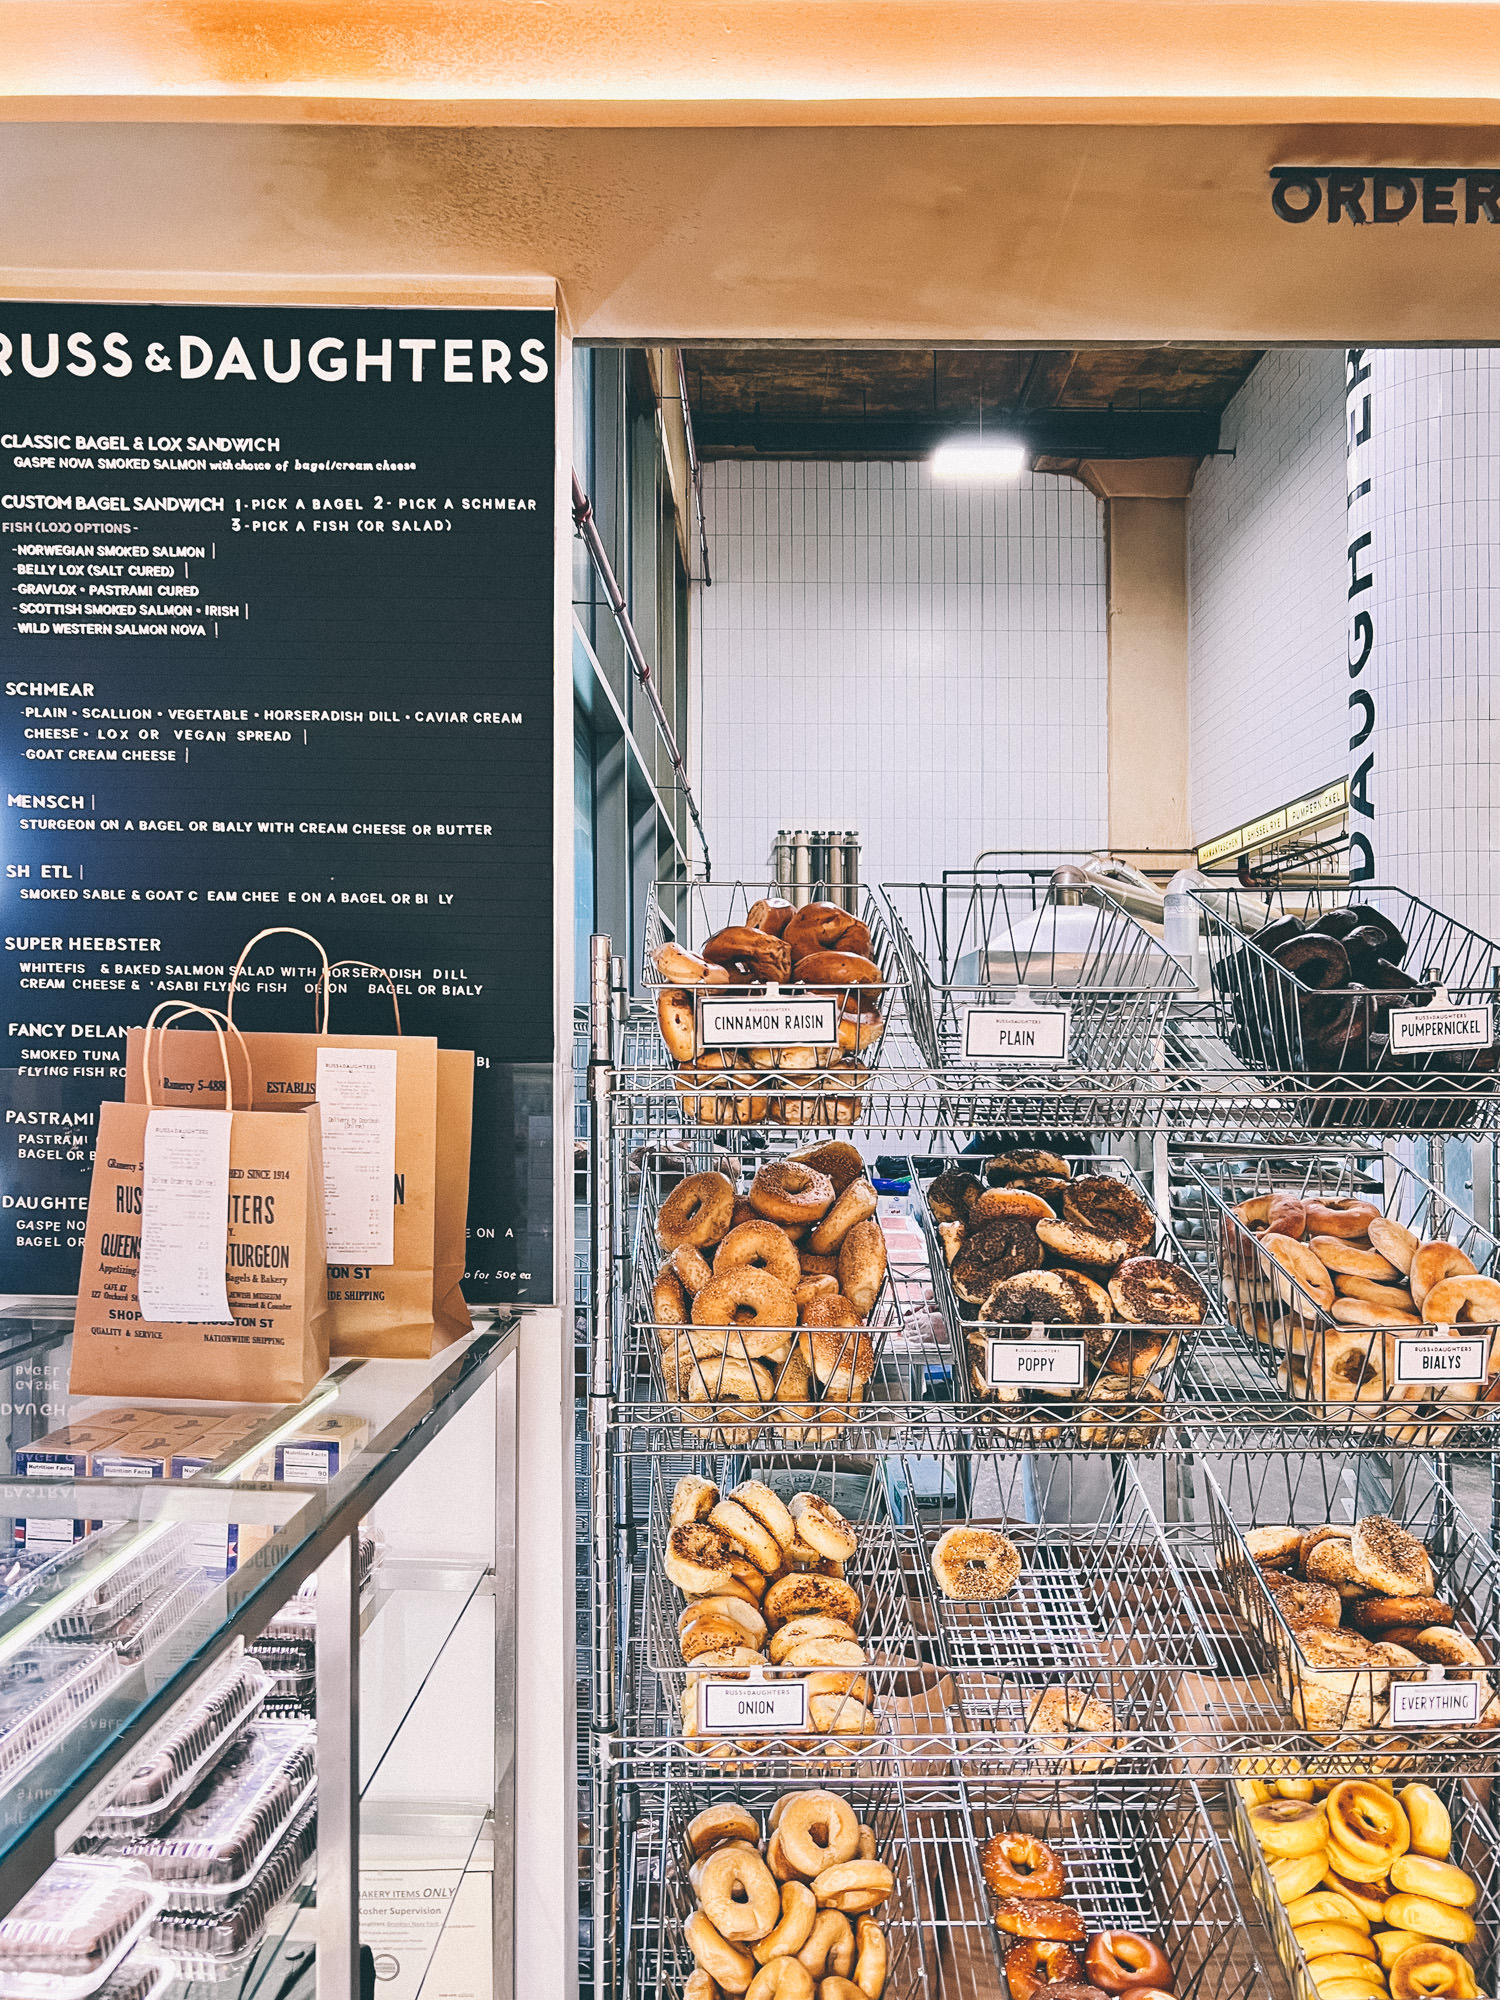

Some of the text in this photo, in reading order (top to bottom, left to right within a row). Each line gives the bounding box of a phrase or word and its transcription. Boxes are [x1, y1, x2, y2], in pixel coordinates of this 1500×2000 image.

[1271, 171, 1500, 225] ORDER
[145, 343, 172, 372] &
[180, 336, 548, 383] DAUGHTERS
[1, 435, 279, 452] CLASSIC BAGEL LOX SANDWICH
[14, 457, 55, 468] GASPE
[59, 458, 94, 468] NOVA
[98, 458, 150, 469] SMOKED
[153, 459, 206, 470] SALMON
[275, 461, 289, 471] of
[376, 460, 416, 470] cheese
[2, 495, 536, 512] CUSTOM BAGEL SANDWICH BAGEL PICK SCHMEAR
[3, 522, 71, 533] FISH (LOX)
[314, 520, 451, 532] FISH (OR SALAD)
[97, 546, 149, 557] SMOKED
[153, 547, 204, 558] SALMON
[59, 565, 84, 575] LOX
[87, 565, 124, 576] (SALT
[128, 565, 174, 577] CURED)
[89, 585, 152, 596] PASTRAMI
[158, 585, 199, 596] CURED
[85, 604, 136, 615] SMOKED
[139, 605, 192, 616] SALMON
[205, 605, 239, 616] IRISH
[53, 623, 112, 634] WESTERN
[115, 624, 167, 634] SALMON
[171, 625, 206, 635] NOVA
[6, 682, 93, 696] SCHMEAR
[83, 708, 151, 719] SCALLION
[168, 709, 248, 720] VEGETABLE
[264, 710, 363, 722] HORSERADISH
[370, 711, 400, 721] DILL
[415, 712, 467, 722] CAVIAR
[474, 713, 521, 723] CREAM
[24, 728, 291, 741] CHEESE LOX OR VEGAN SPREAD
[69, 750, 117, 760] CREAM
[122, 750, 175, 760] CHEESE
[8, 795, 83, 808] MENSCH
[20, 819, 491, 835] STURGEON ON BAGEL OR BIALY WITH CREAM CHEESE OR BUTTER
[21, 889, 410, 904] SMOKED SABLE GOAT ON BAGEL OR
[5, 937, 160, 951] SUPER HEEBSTER
[115, 964, 467, 979] BAKED SALMON SALAD WITH DILL
[20, 979, 64, 988] CREAM
[73, 979, 125, 990] CHEESE
[257, 983, 286, 992] FISH
[368, 983, 414, 995] BAGEL
[418, 984, 437, 995] OR
[443, 984, 483, 997] BIALY
[714, 1014, 824, 1031] CINNAMON RAISIN
[1401, 1019, 1481, 1038] PUMPERNICKEL
[9, 1023, 65, 1037] FANCY
[999, 1030, 1035, 1046] PLAIN
[22, 1050, 119, 1061] SMOKED TUNA
[18, 1066, 104, 1076] FLYING FISH
[6, 1111, 93, 1126] PASTRAMI
[19, 1133, 87, 1146] PASTRAMI
[19, 1147, 84, 1160] BAGEL OR
[247, 1169, 290, 1180] SINCE 1914
[17, 1220, 60, 1231] GASPE
[477, 1228, 494, 1237] ON
[17, 1237, 61, 1247] BAGEL
[353, 1266, 372, 1280] ST
[260, 1274, 288, 1286] Bakery
[344, 1290, 385, 1301] SHIPPING
[259, 1318, 274, 1329] ST
[91, 1326, 163, 1340] QUALITY SERVICE
[203, 1333, 285, 1346] NATIONWIDE SHIPPING
[1017, 1356, 1056, 1374] POPPY
[1422, 1354, 1462, 1371] BIALYS
[737, 1700, 775, 1716] ONION
[1401, 1695, 1469, 1711] EVERYTHING
[359, 1887, 456, 1899] AKERY ITEMS ONLY
[389, 1906, 442, 1917] Supervision
